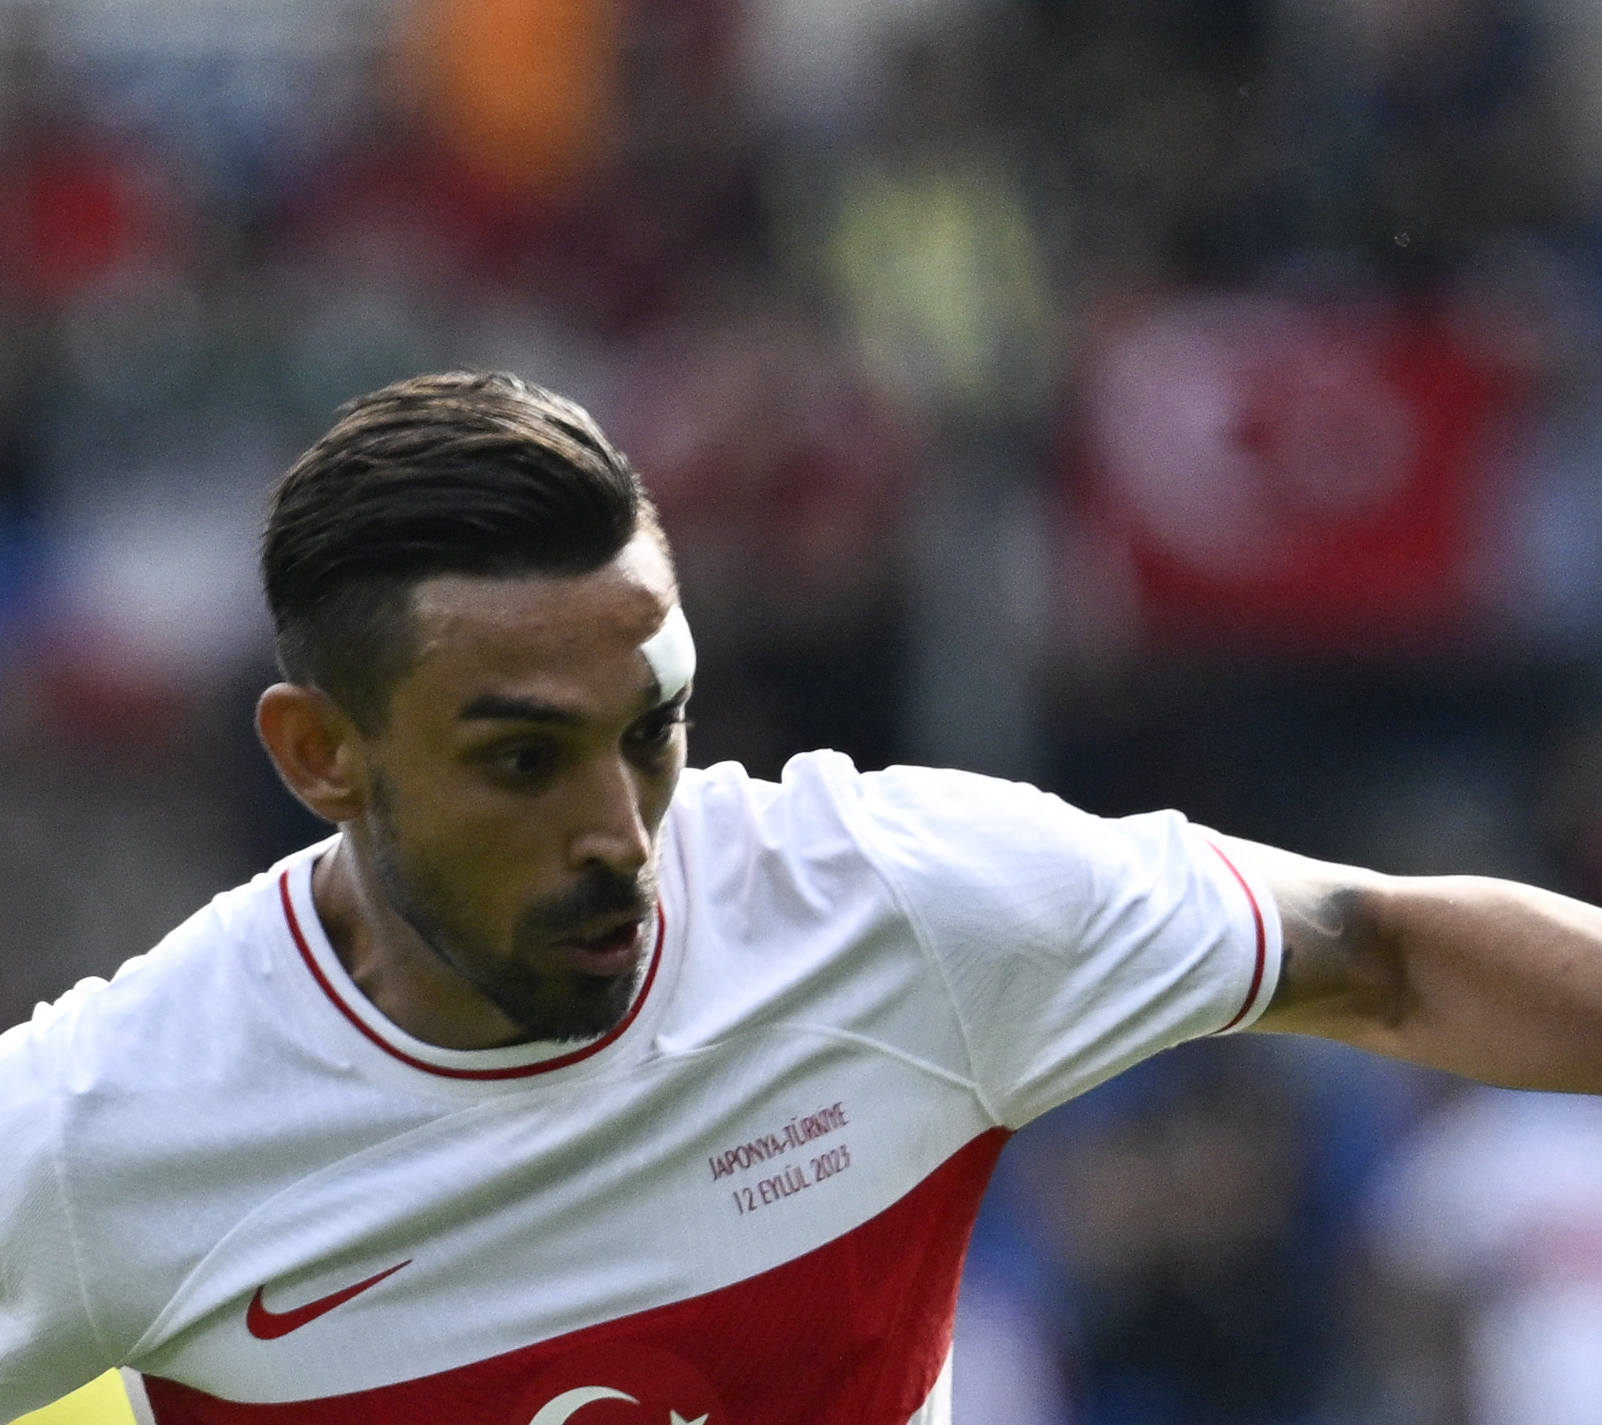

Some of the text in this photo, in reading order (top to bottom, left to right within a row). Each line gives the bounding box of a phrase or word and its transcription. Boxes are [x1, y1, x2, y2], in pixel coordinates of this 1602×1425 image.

[732, 1144, 851, 1215] 12 EYLÜL 2023
